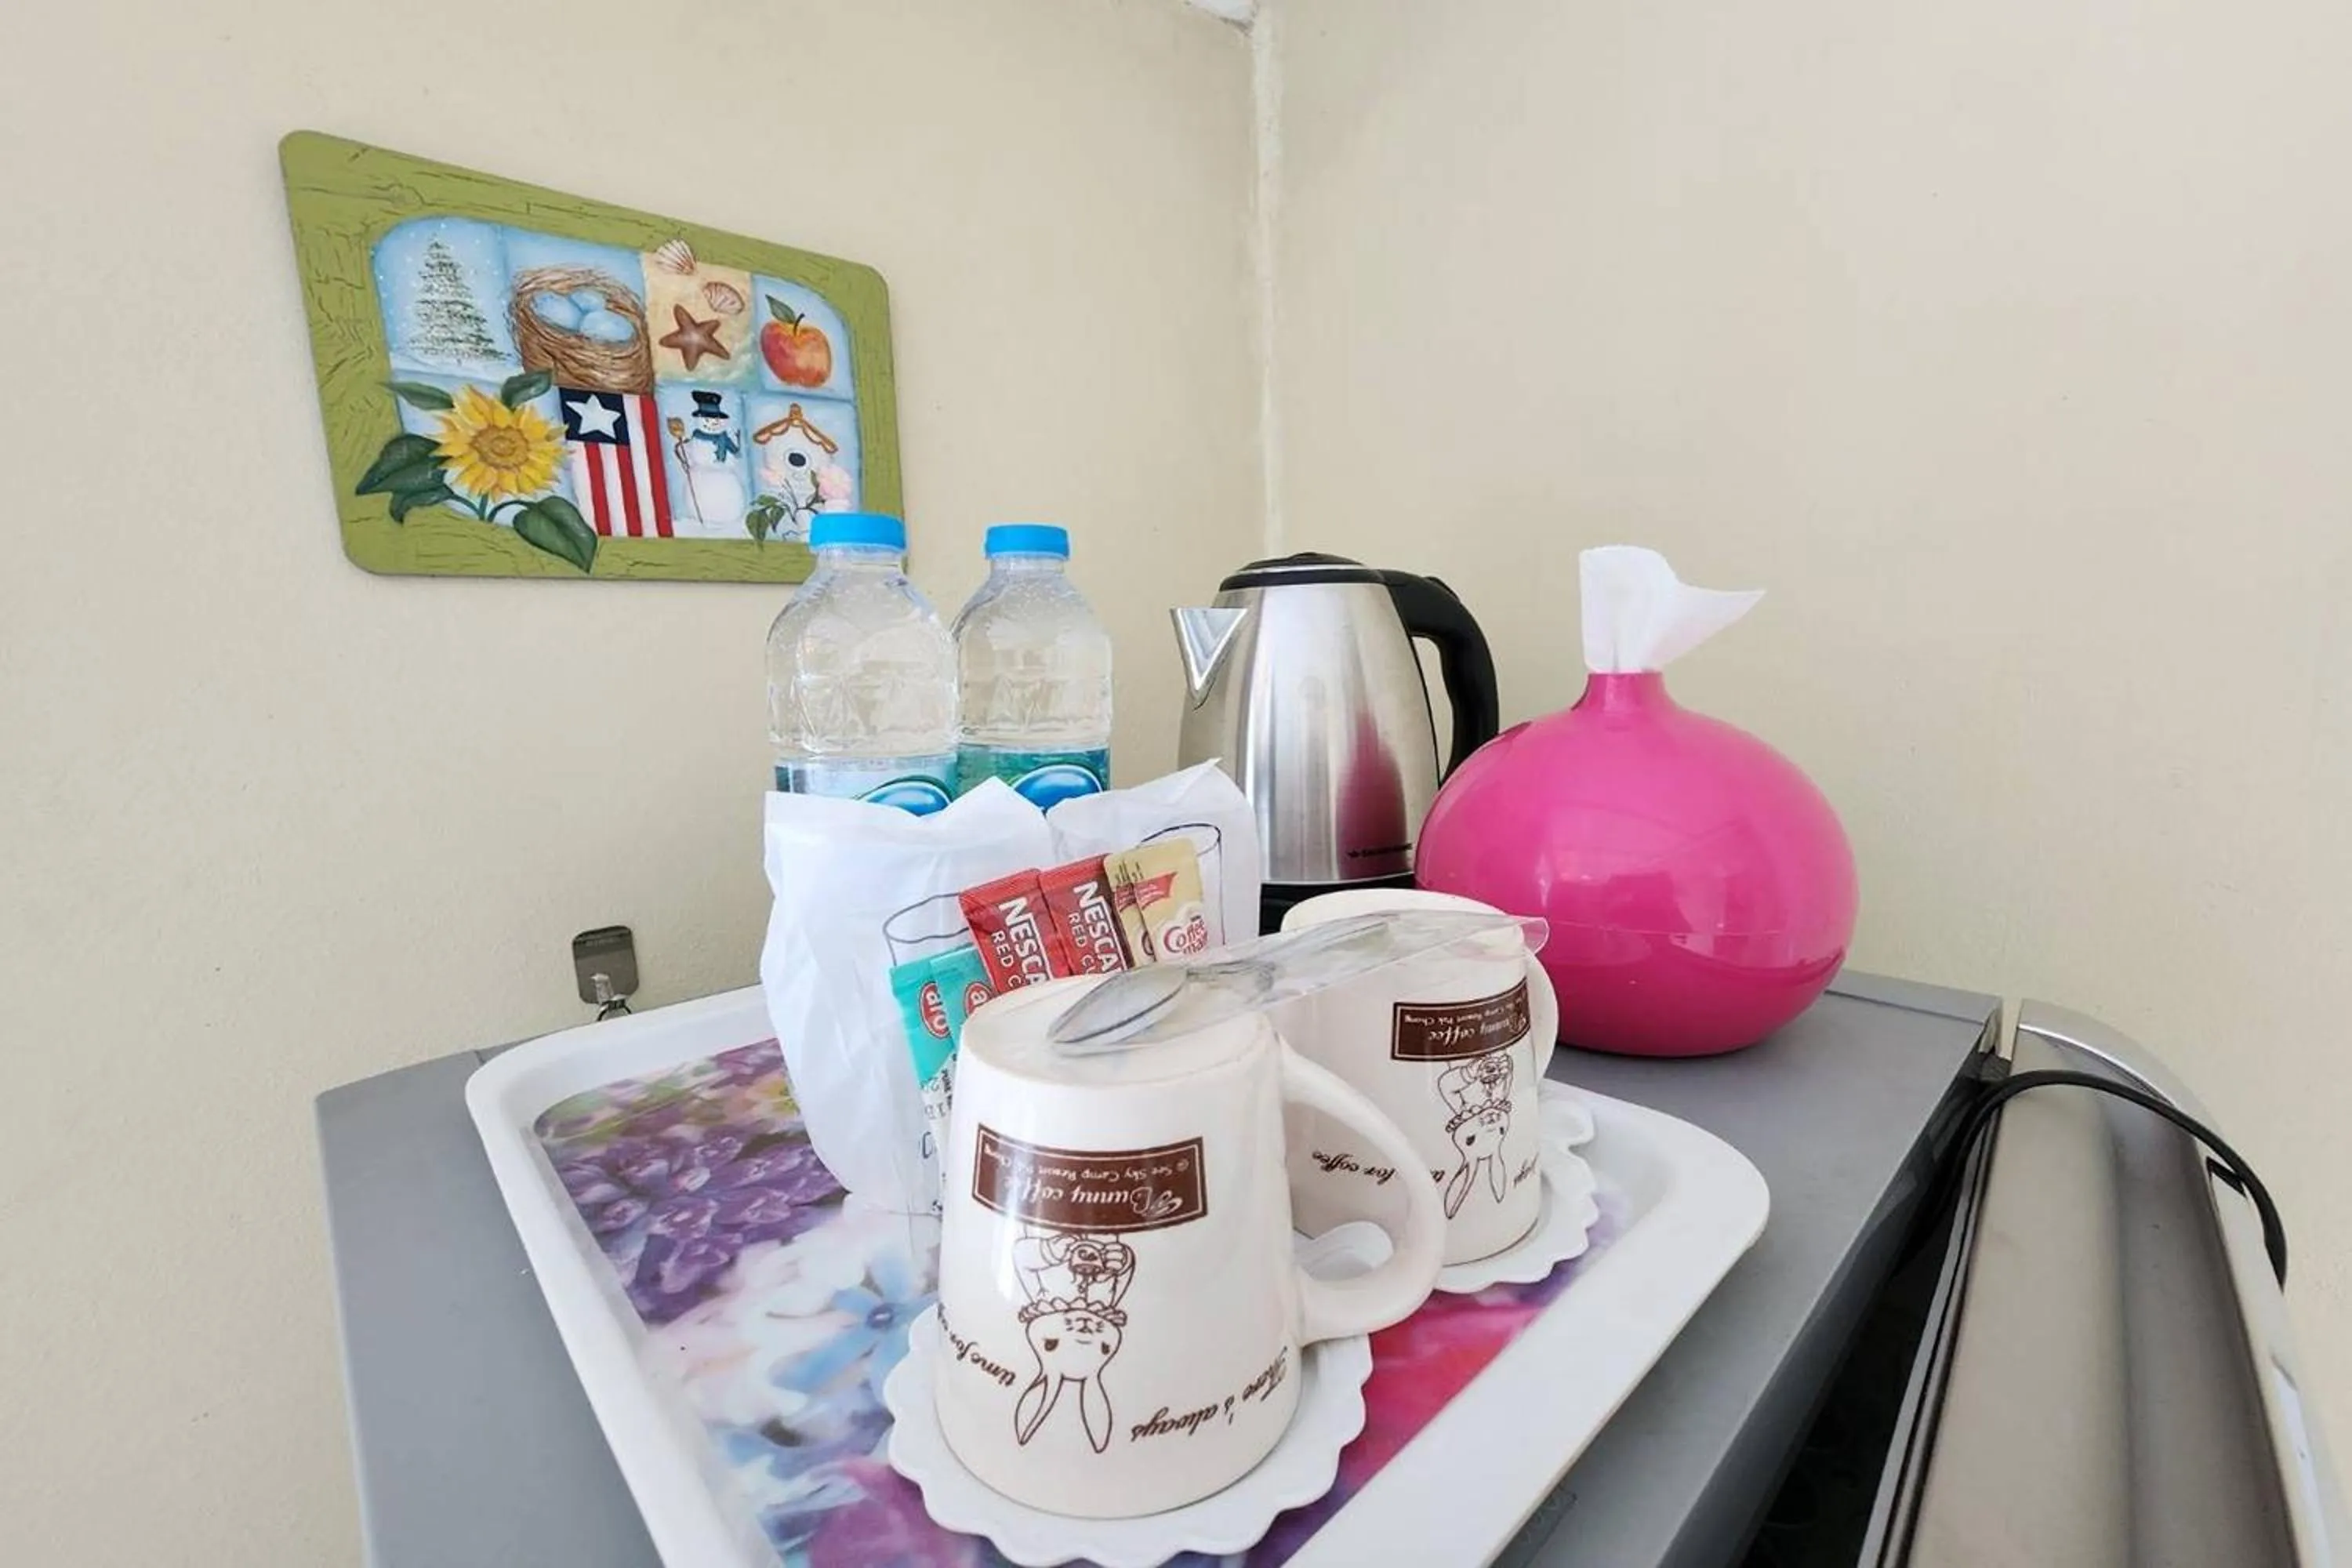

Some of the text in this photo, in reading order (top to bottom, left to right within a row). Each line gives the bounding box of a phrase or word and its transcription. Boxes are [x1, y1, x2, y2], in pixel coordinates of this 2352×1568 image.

[999, 897, 1052, 985] NESCA
[1068, 913, 1087, 949] RED
[1073, 881, 1127, 973] NESCA
[991, 931, 1014, 968] RED
[1427, 1025, 1475, 1047] coffee
[1081, 1167, 1120, 1182] Camp
[1124, 1167, 1148, 1181] Sky
[1312, 1152, 1360, 1173] coffee
[971, 1352, 1016, 1388] time
[1131, 1406, 1218, 1443] always
